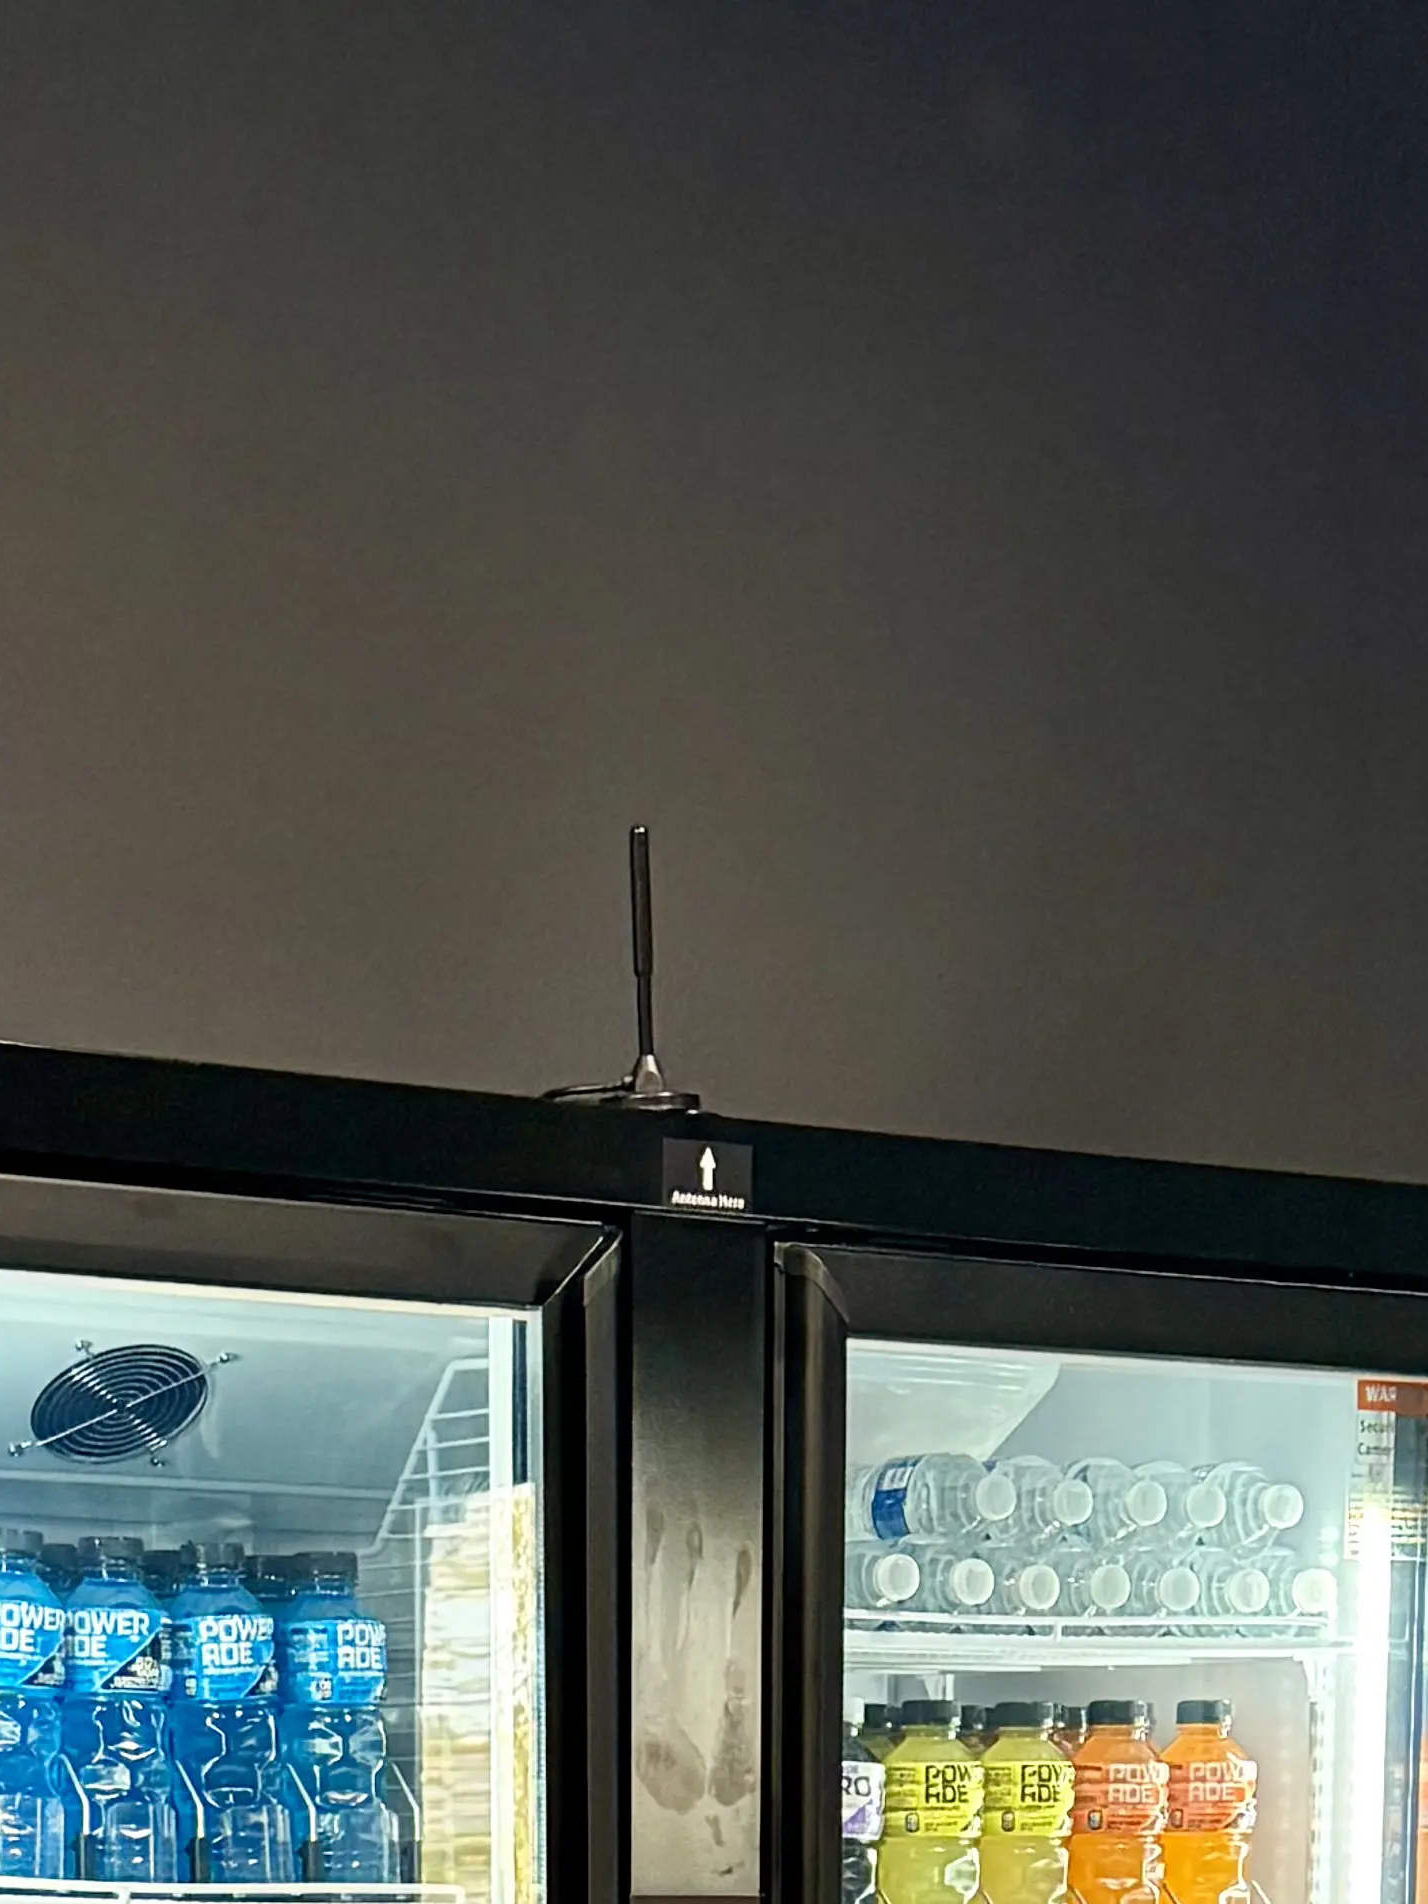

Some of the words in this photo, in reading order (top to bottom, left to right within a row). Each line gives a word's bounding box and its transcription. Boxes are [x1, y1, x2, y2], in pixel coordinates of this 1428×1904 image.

[201, 1642, 254, 1667] ADE
[925, 1784, 970, 1804] ADE
[1108, 1784, 1157, 1803] ADE
